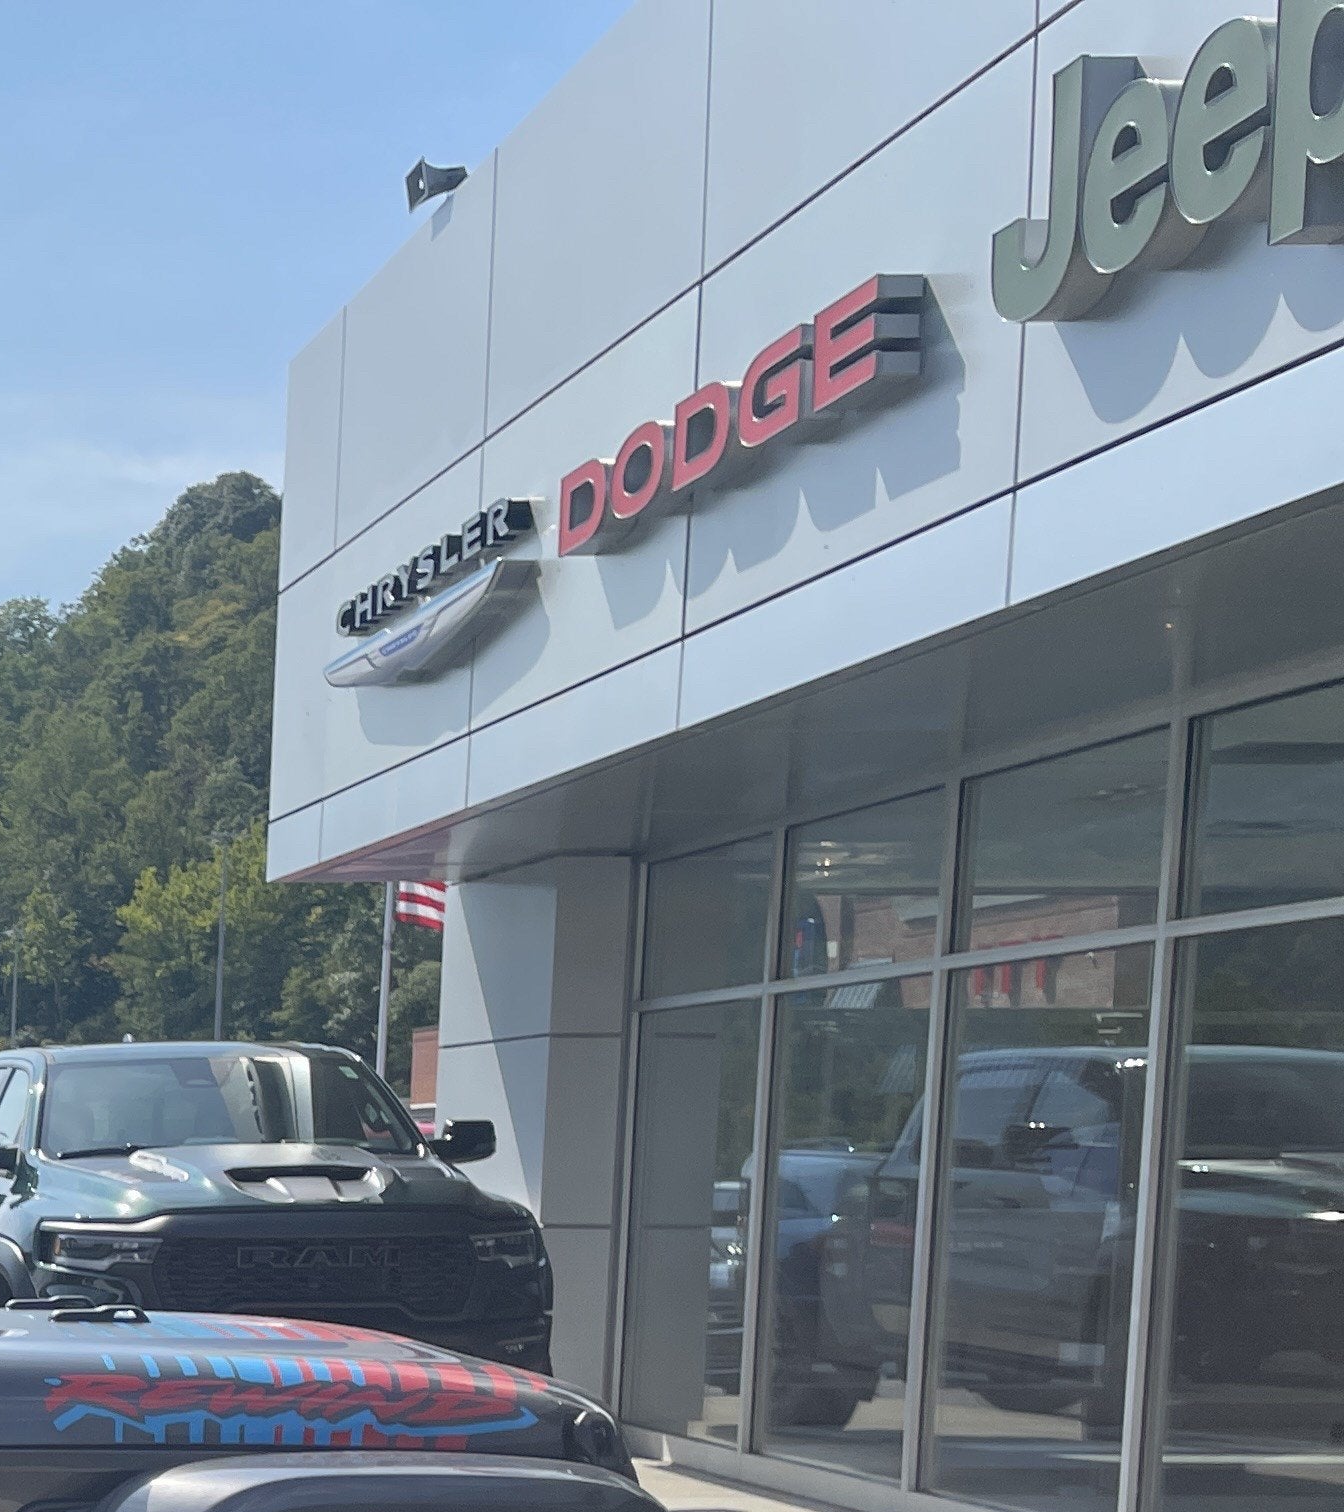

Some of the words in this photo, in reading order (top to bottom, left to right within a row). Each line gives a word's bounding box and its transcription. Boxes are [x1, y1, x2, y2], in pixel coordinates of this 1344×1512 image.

[991, 0, 1344, 322] Jeep
[558, 273, 880, 557] DODGE
[336, 497, 512, 638] CHRYSLER
[236, 1245, 402, 1268] RAM
[44, 1374, 523, 1421] REWIND
